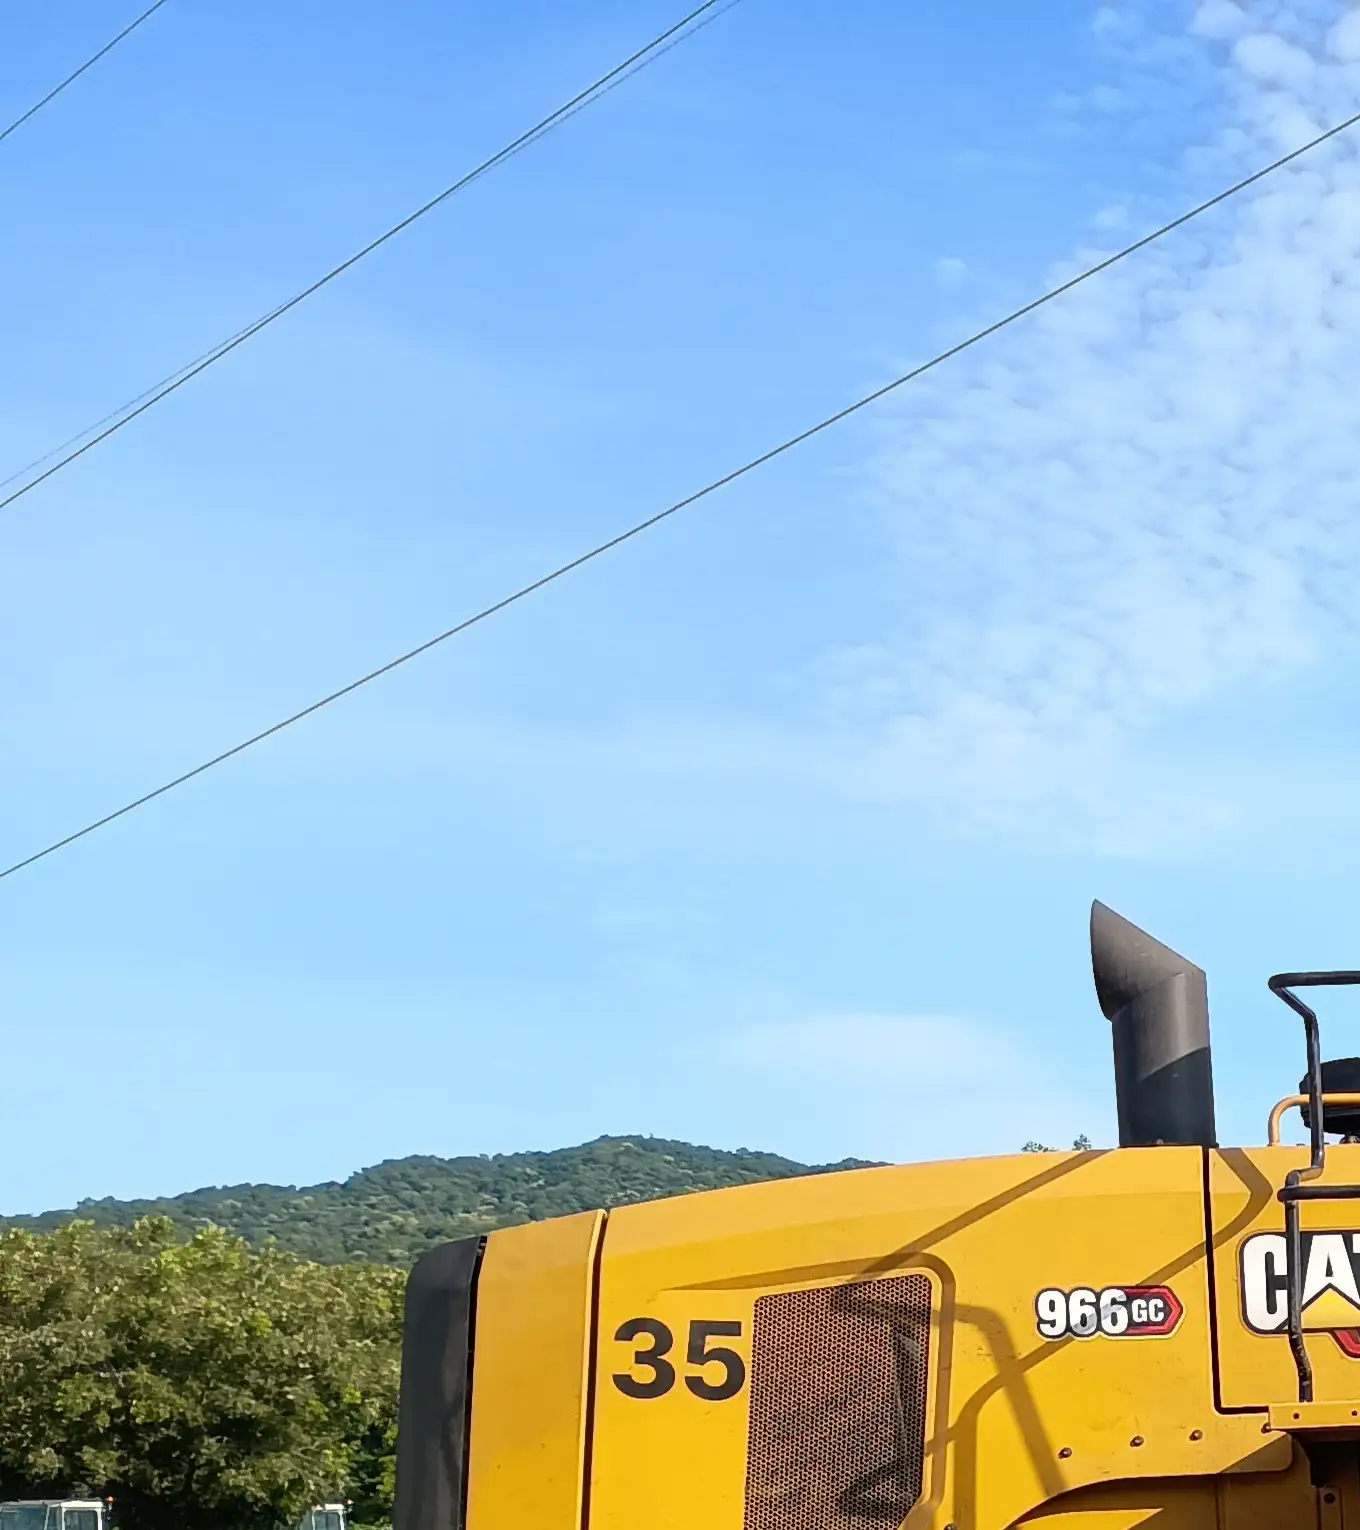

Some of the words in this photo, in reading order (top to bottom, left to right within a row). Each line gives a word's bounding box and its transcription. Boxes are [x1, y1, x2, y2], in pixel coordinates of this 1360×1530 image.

[1037, 1287, 1129, 1337] 966
[1131, 1298, 1165, 1323] GC
[612, 1317, 746, 1402] 35
